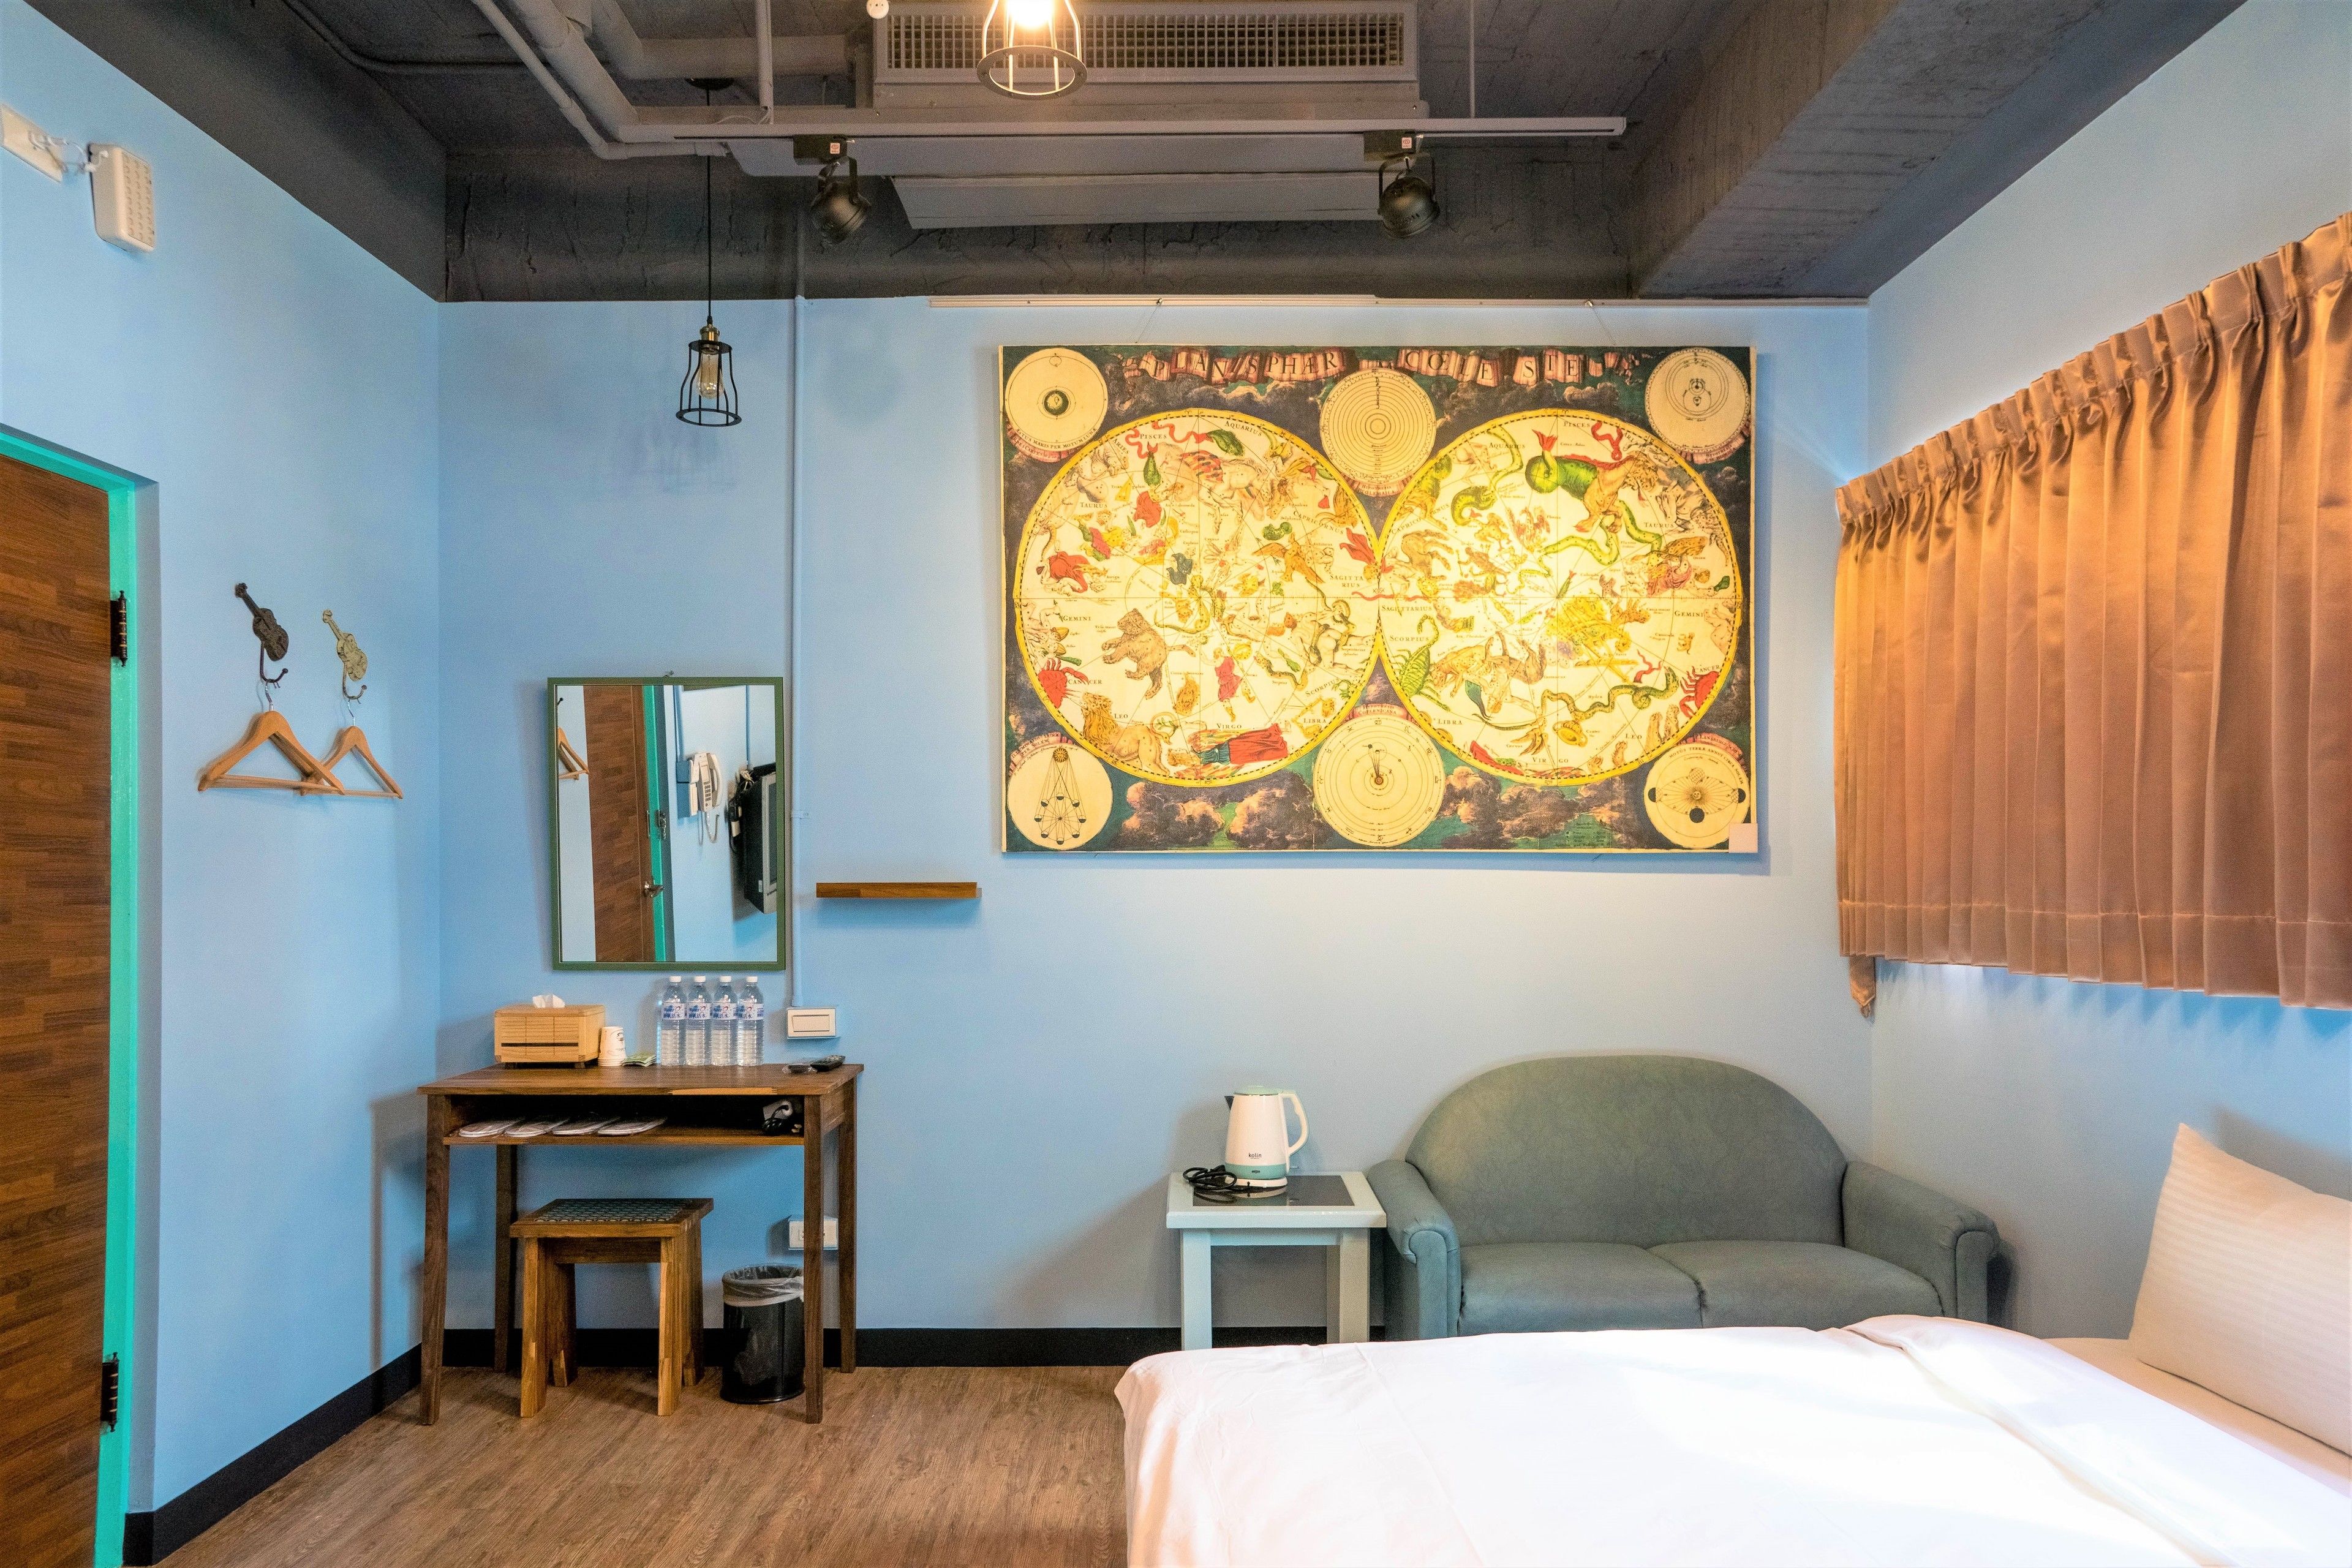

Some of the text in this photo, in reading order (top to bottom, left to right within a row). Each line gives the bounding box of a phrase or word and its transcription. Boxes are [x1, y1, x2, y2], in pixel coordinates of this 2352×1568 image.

[1225, 420, 1263, 437] AQUARIUS
[1113, 438, 1129, 454] ARIES
[1293, 510, 1344, 535] CAPRICORNUS
[1305, 677, 1340, 696] SCORPIUS
